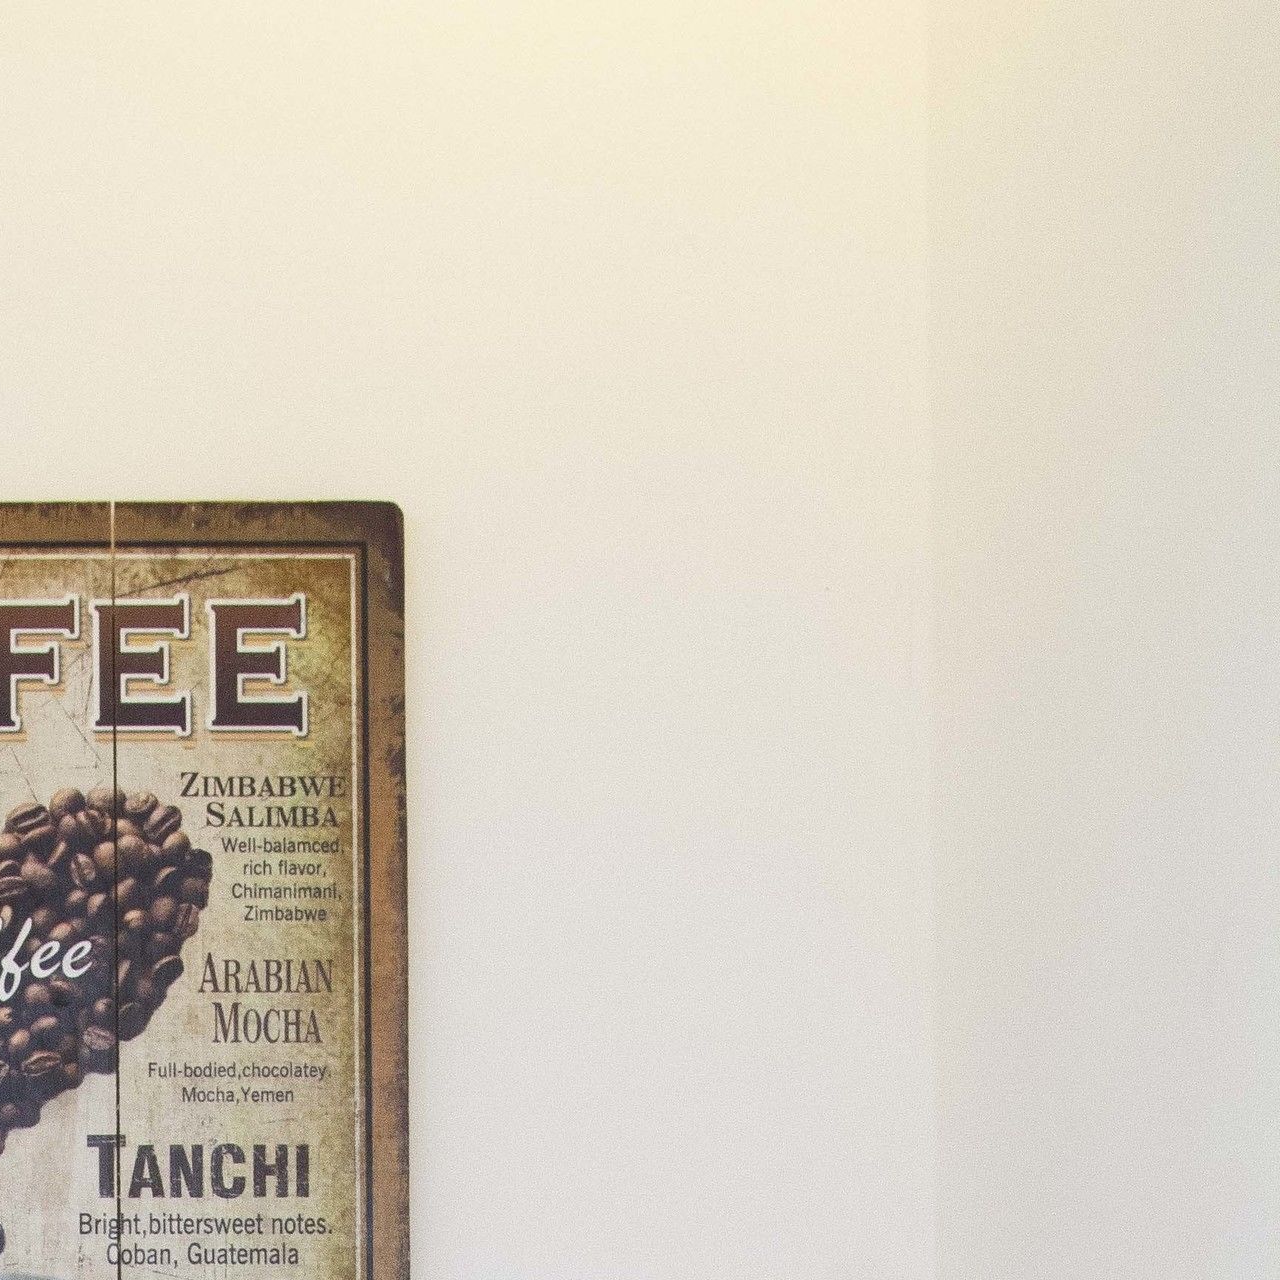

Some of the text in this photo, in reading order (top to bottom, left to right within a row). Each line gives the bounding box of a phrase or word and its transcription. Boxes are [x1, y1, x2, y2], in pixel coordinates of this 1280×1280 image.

[180, 771, 347, 798] ZIMBABWE
[206, 802, 340, 828] SALIMBA
[243, 860, 272, 876] rich
[244, 904, 328, 922] Zimbabwe
[198, 951, 334, 994] ARABIAN
[212, 1001, 323, 1044] MOCHA
[86, 1133, 310, 1199] TANCHI
[187, 1241, 299, 1266] Guatemala
